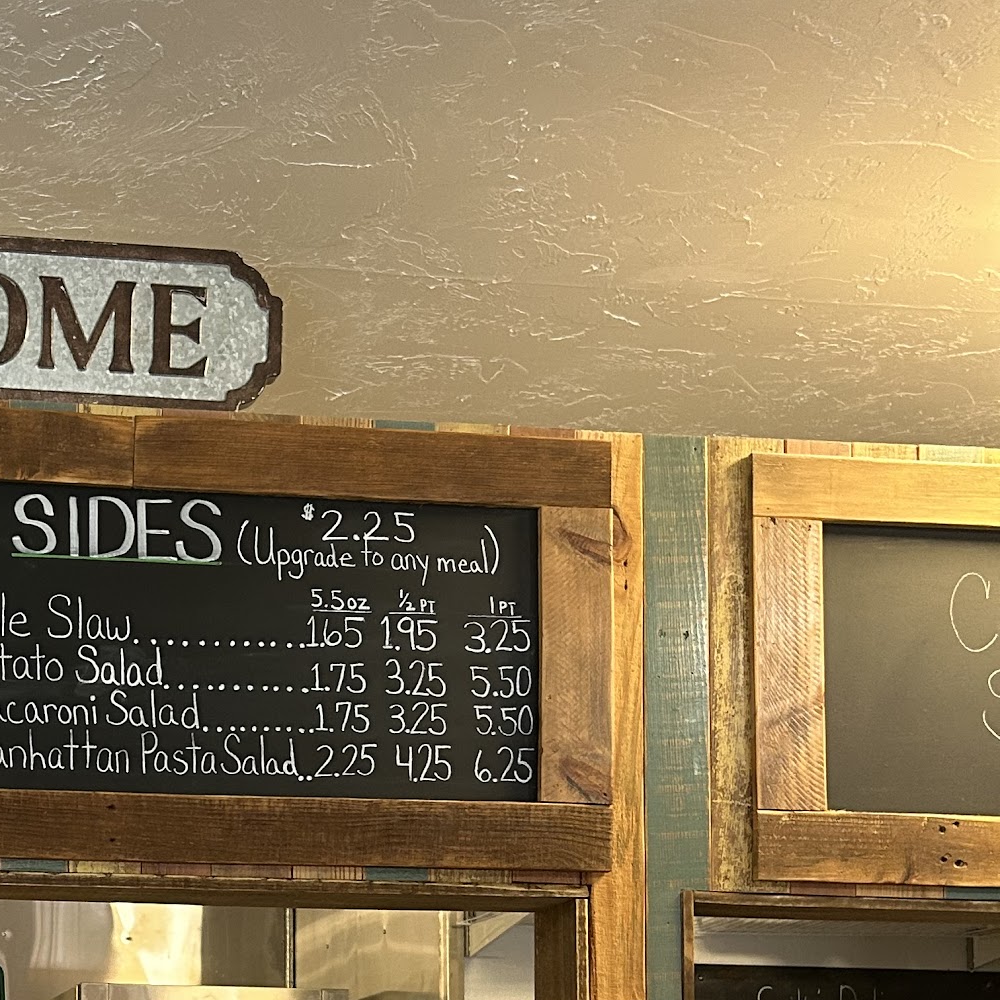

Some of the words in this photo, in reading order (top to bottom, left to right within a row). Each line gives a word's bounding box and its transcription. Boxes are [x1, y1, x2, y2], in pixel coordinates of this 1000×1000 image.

[11, 493, 223, 563] SIDES
[301, 503, 416, 543] $2.25
[237, 519, 356, 581] (Upgrade
[361, 538, 384, 567] to
[390, 552, 429, 586] any
[437, 524, 499, 575] meal)
[47, 593, 131, 642] Slaw
[305, 616, 366, 648] 1.65
[379, 616, 439, 651] 1.95
[463, 619, 532, 654] 3.25
[75, 644, 164, 688] Salad
[310, 662, 367, 694] 1.75
[385, 658, 447, 697] 3.25
[469, 665, 533, 698] 5.50
[106, 688, 201, 729] Salad
[314, 701, 371, 733] 1.75
[388, 701, 448, 735] 3.25
[473, 704, 534, 737] 5.50
[140, 730, 219, 775] Pasta
[220, 733, 300, 777] Salad
[314, 744, 378, 778] 2.25
[395, 743, 452, 783] 4.25
[473, 746, 536, 784] 6.25
